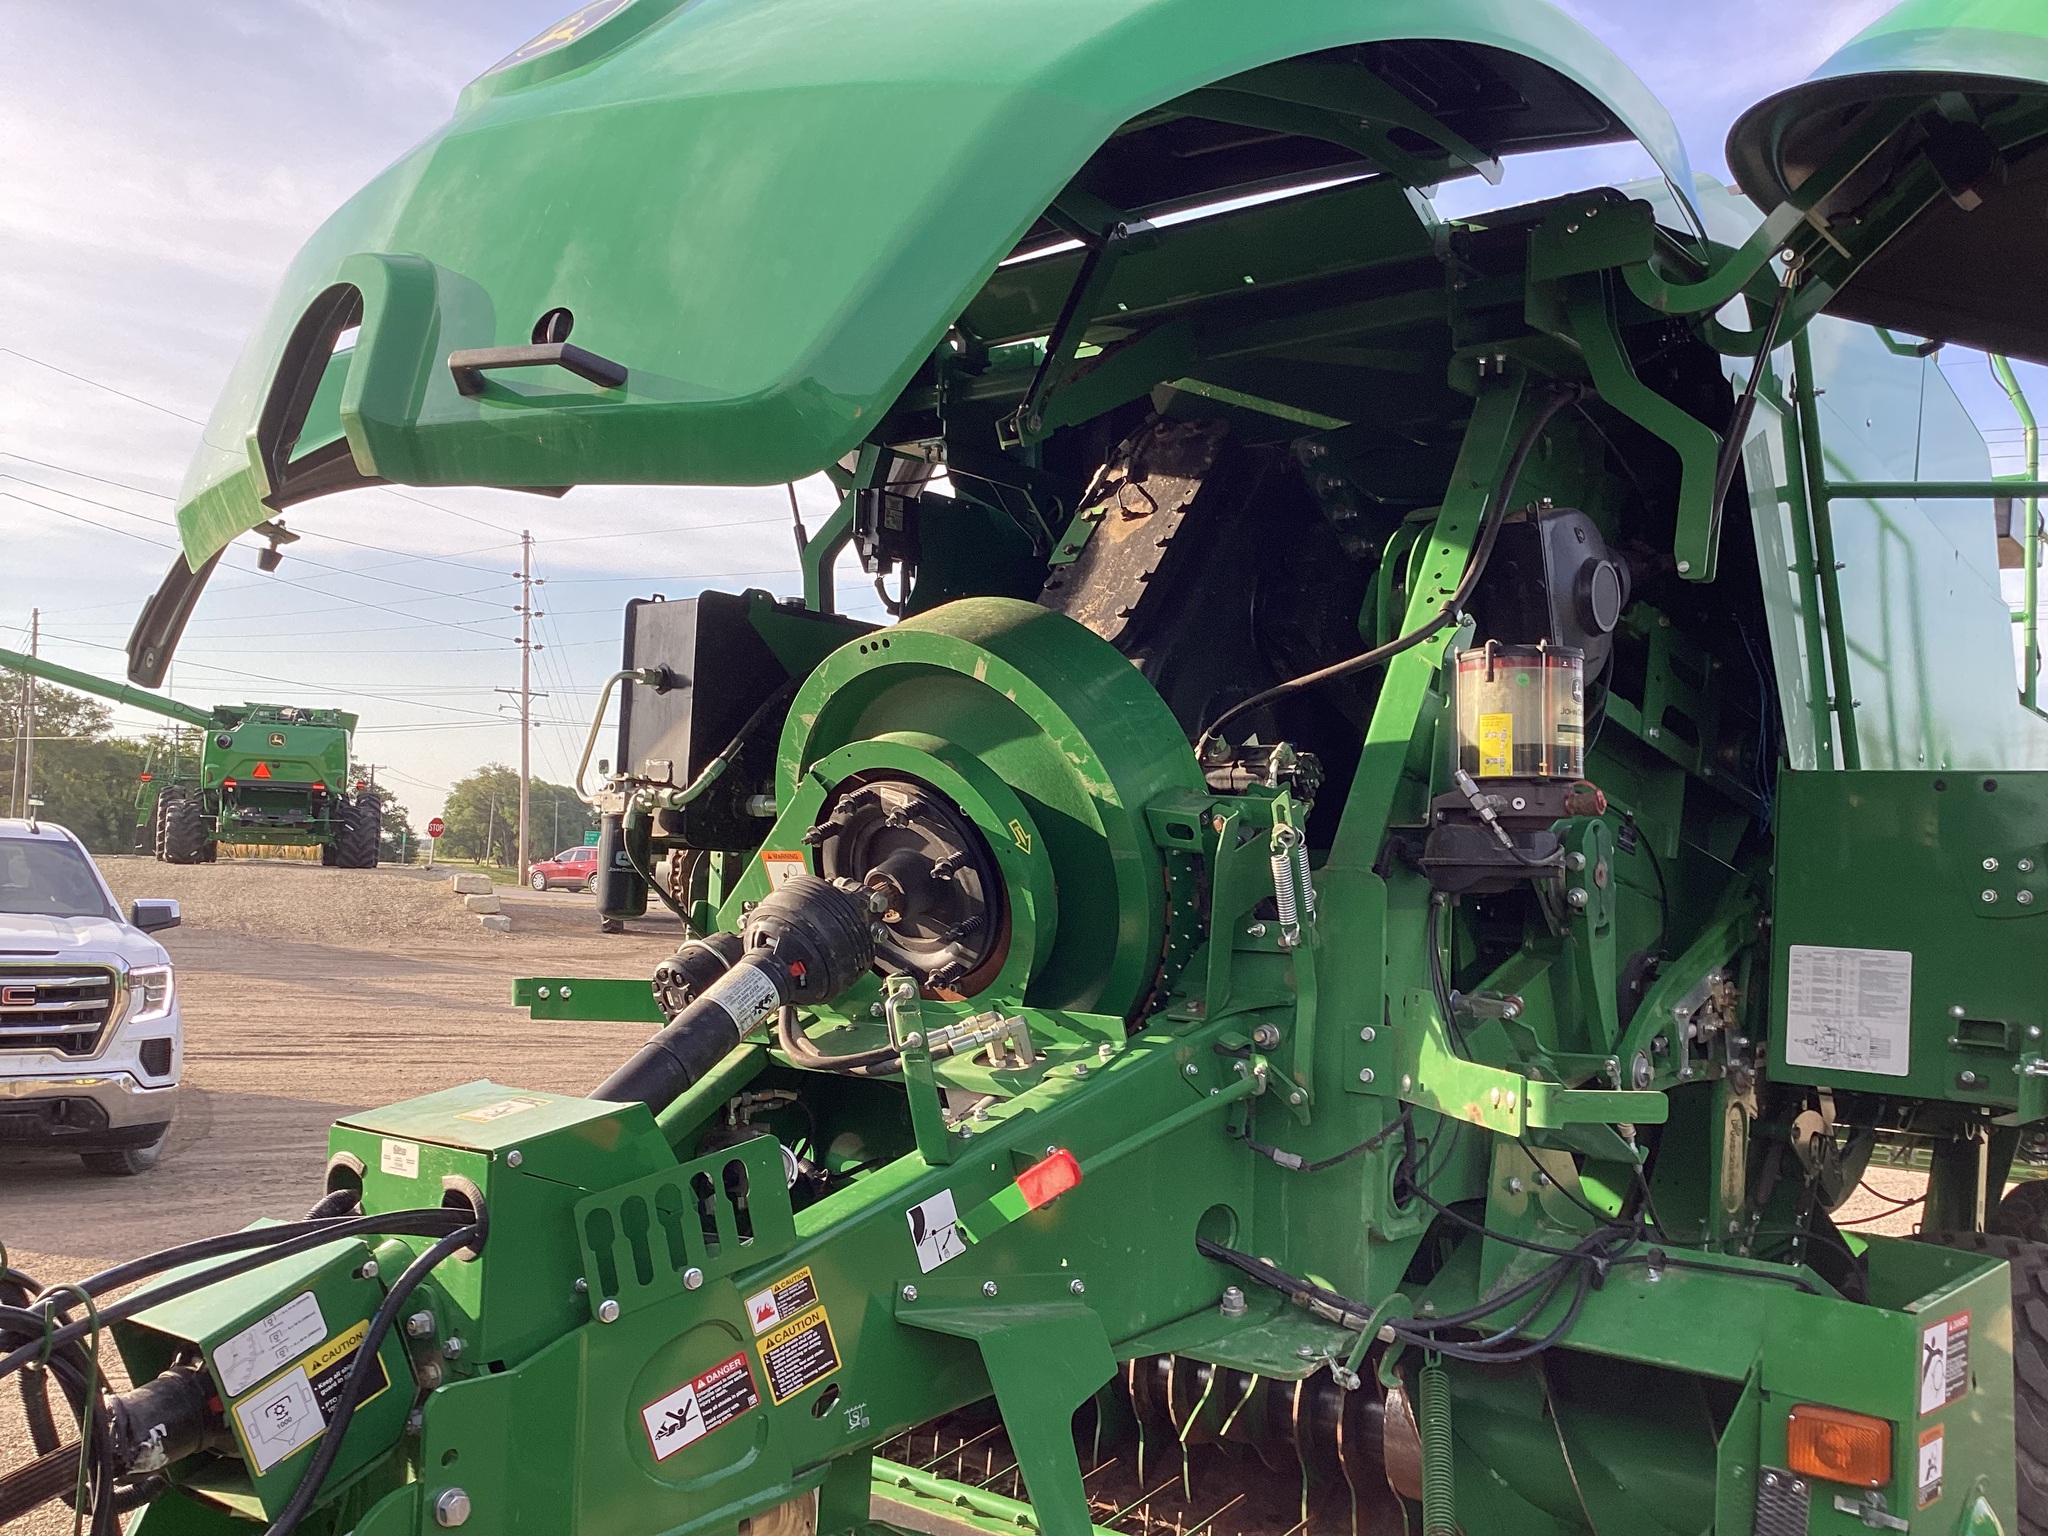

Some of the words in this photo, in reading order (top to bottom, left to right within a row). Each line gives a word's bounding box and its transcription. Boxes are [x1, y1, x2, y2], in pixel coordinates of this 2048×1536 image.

[781, 1270, 808, 1288] CAUTION
[774, 1312, 819, 1343] CAUTION
[322, 1332, 363, 1362] CAUTION
[706, 1359, 741, 1384] DANGER
[318, 1377, 333, 1389] Keep
[320, 1381, 337, 1396] guard
[325, 1397, 337, 1408] PTO
[277, 1416, 292, 1429] 1000
